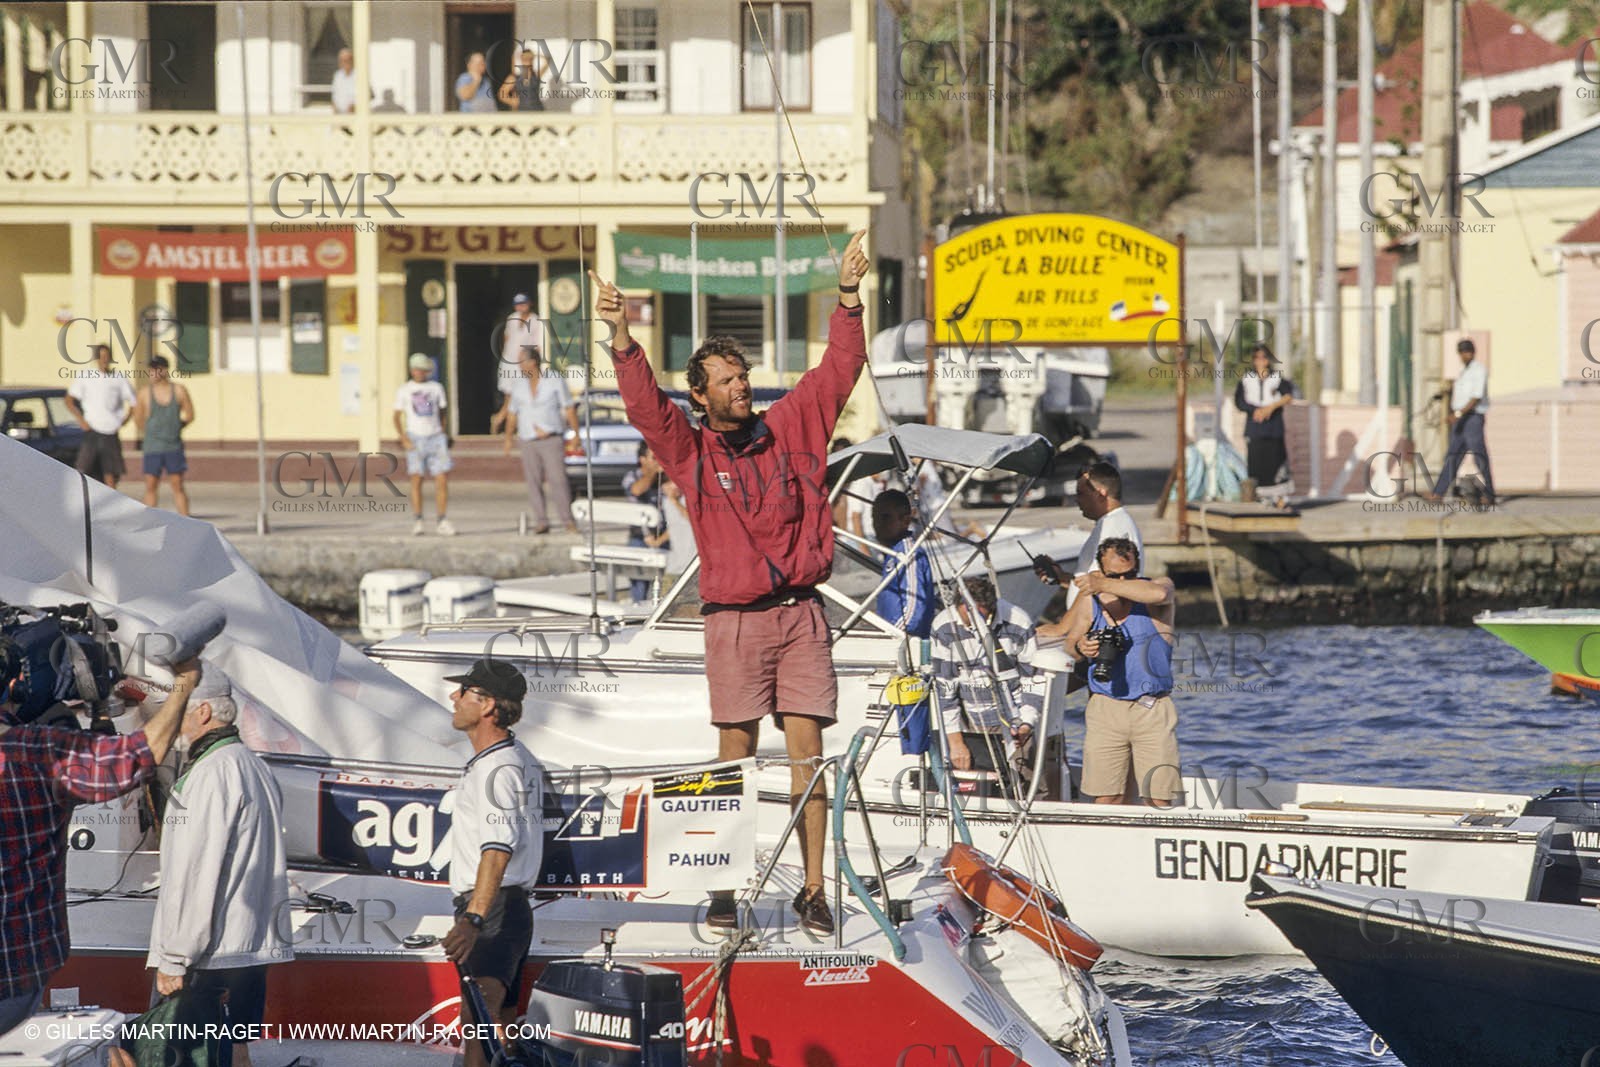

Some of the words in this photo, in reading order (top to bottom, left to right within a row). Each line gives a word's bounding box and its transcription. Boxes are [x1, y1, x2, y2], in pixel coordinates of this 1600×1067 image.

[146, 243, 241, 270] AMSTEL
[945, 235, 1006, 272] SCUBA
[1015, 227, 1084, 246] DIVING
[1097, 231, 1168, 273] CENTER
[1016, 289, 1045, 304] AIR
[1054, 289, 1099, 304] FILLS
[662, 799, 740, 812] GAUTIER
[669, 853, 730, 866] PAHUN
[1155, 838, 1407, 889] GENDARMERIE
[547, 872, 623, 884] BARTH
[803, 955, 875, 969] ANTIFOULING
[575, 1010, 632, 1039] YAMAHA
[659, 1021, 684, 1039] 40
